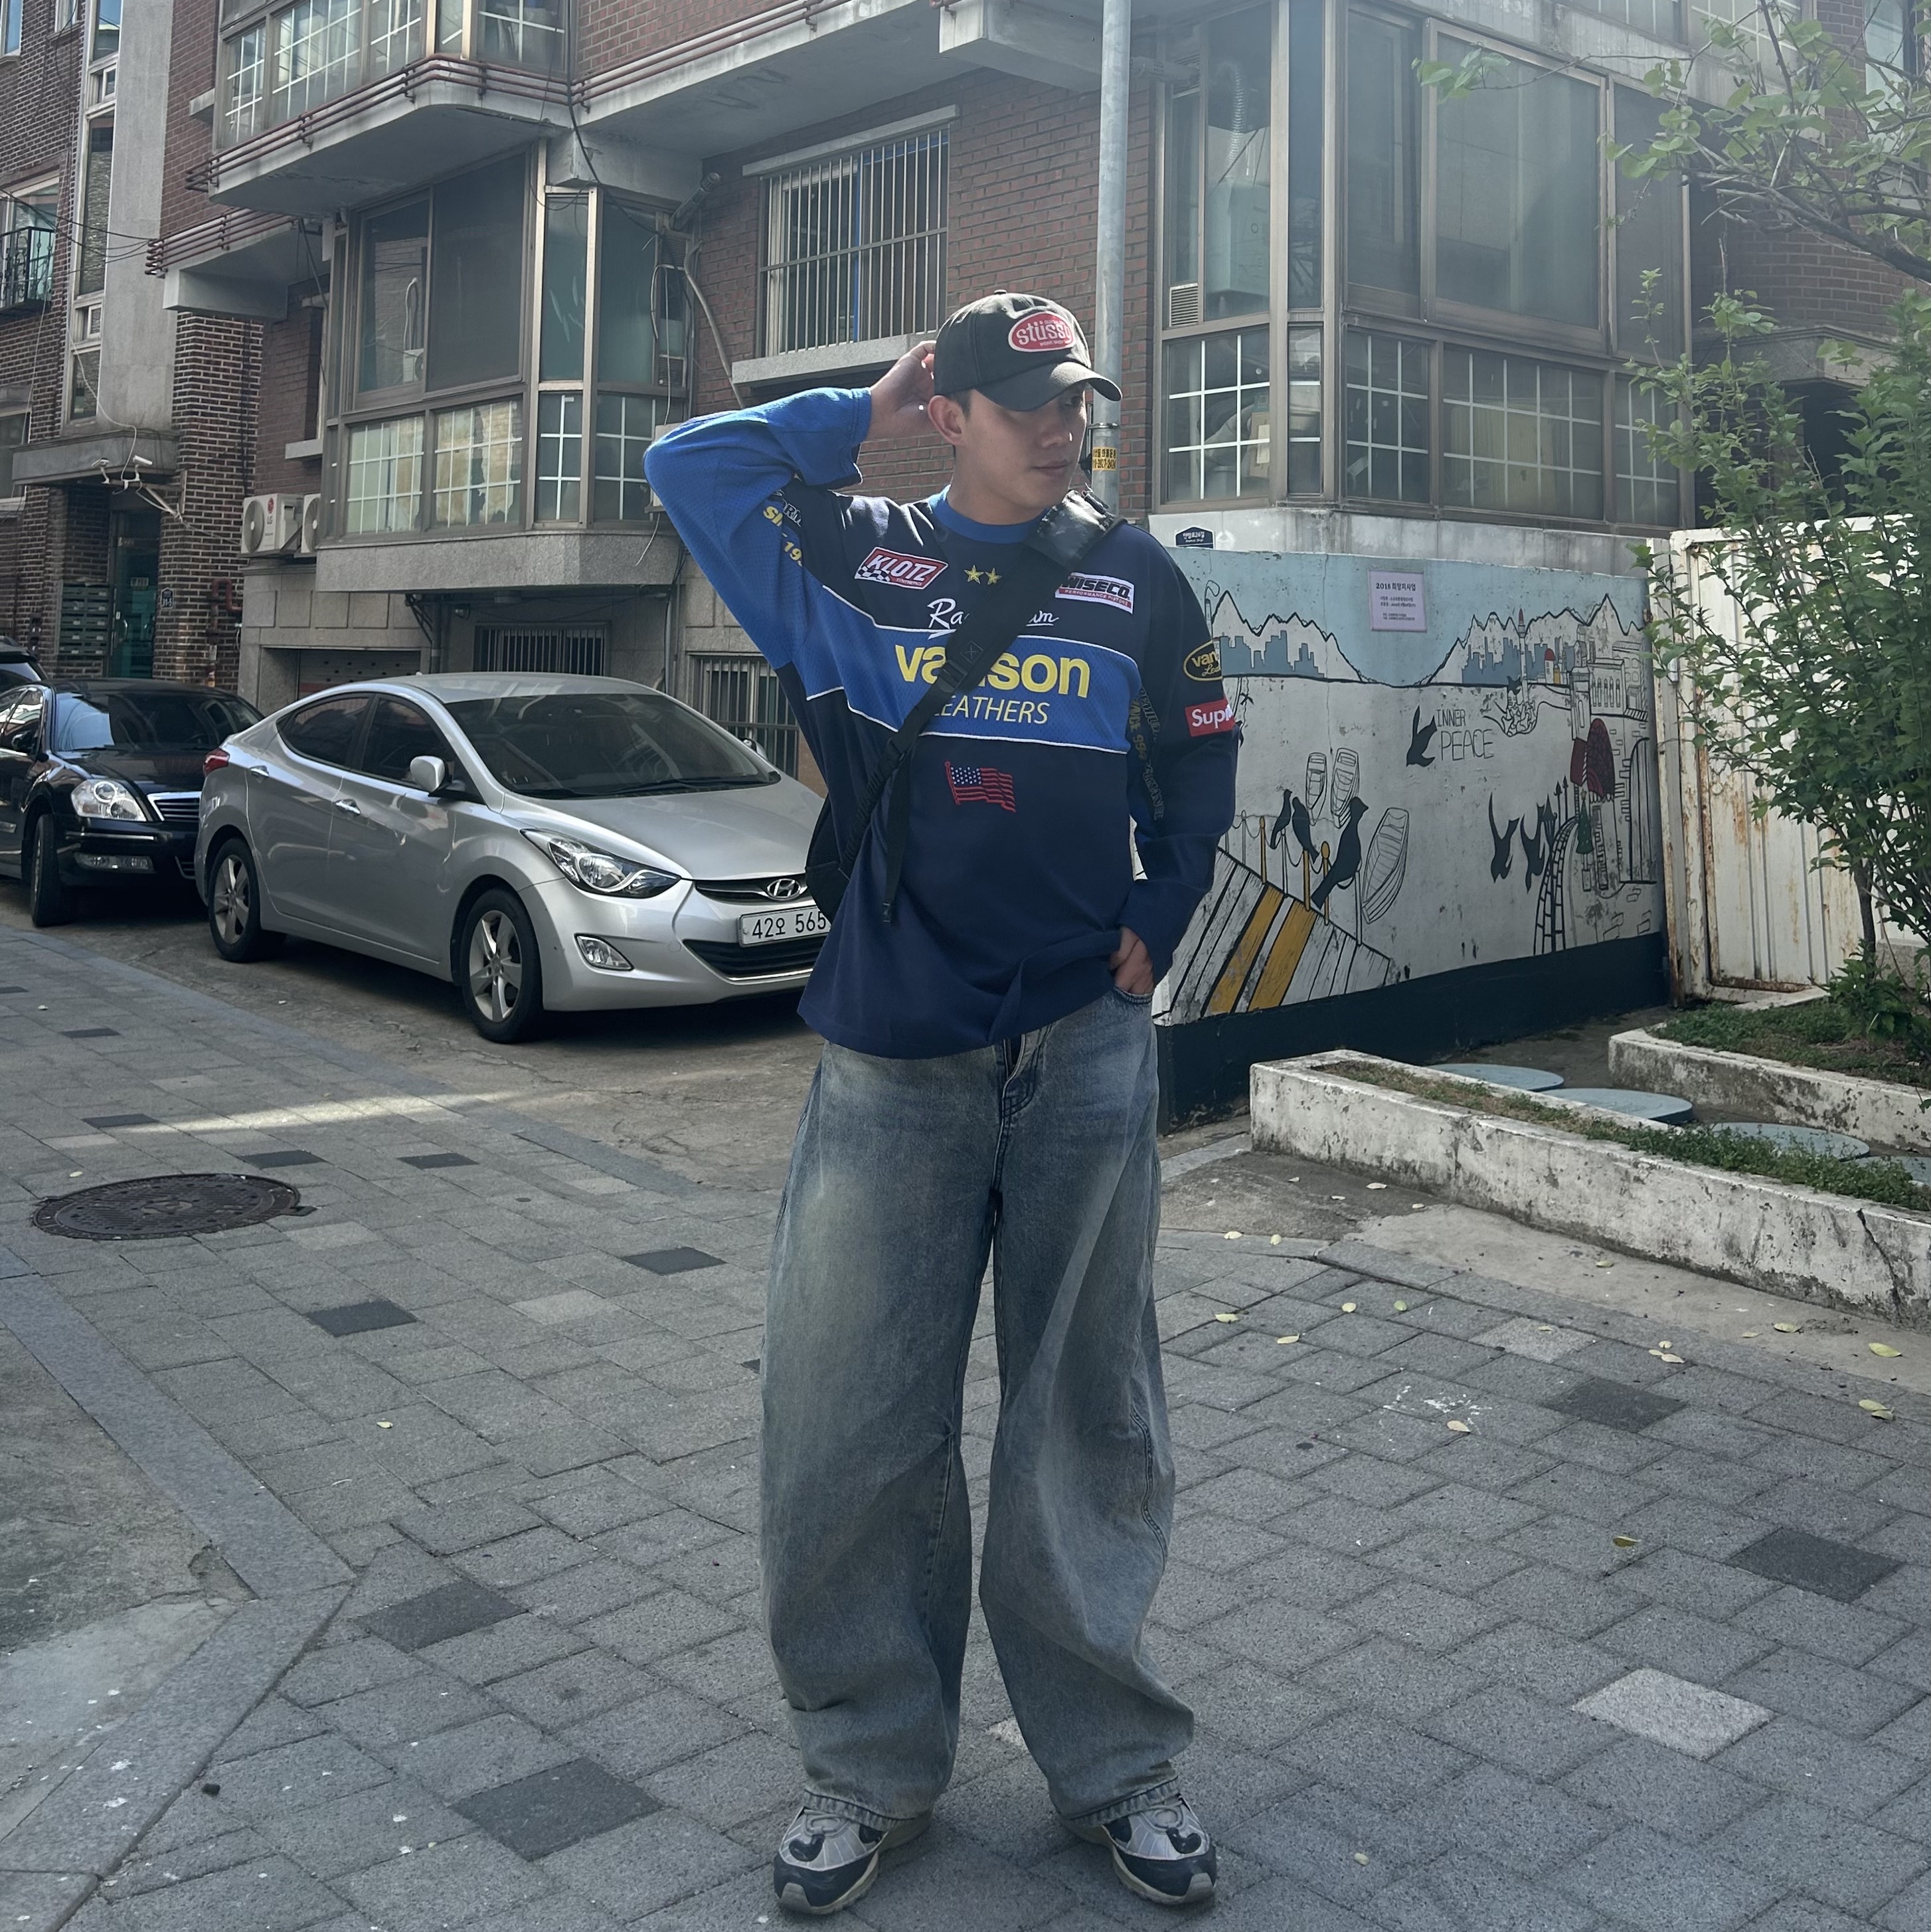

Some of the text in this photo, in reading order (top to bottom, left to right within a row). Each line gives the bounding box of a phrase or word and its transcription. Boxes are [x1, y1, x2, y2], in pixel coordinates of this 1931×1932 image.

[867, 555, 937, 581] KLOTZ
[895, 644, 1090, 698] vason
[1436, 708, 1466, 727] INNER
[1441, 729, 1494, 761] PEACE
